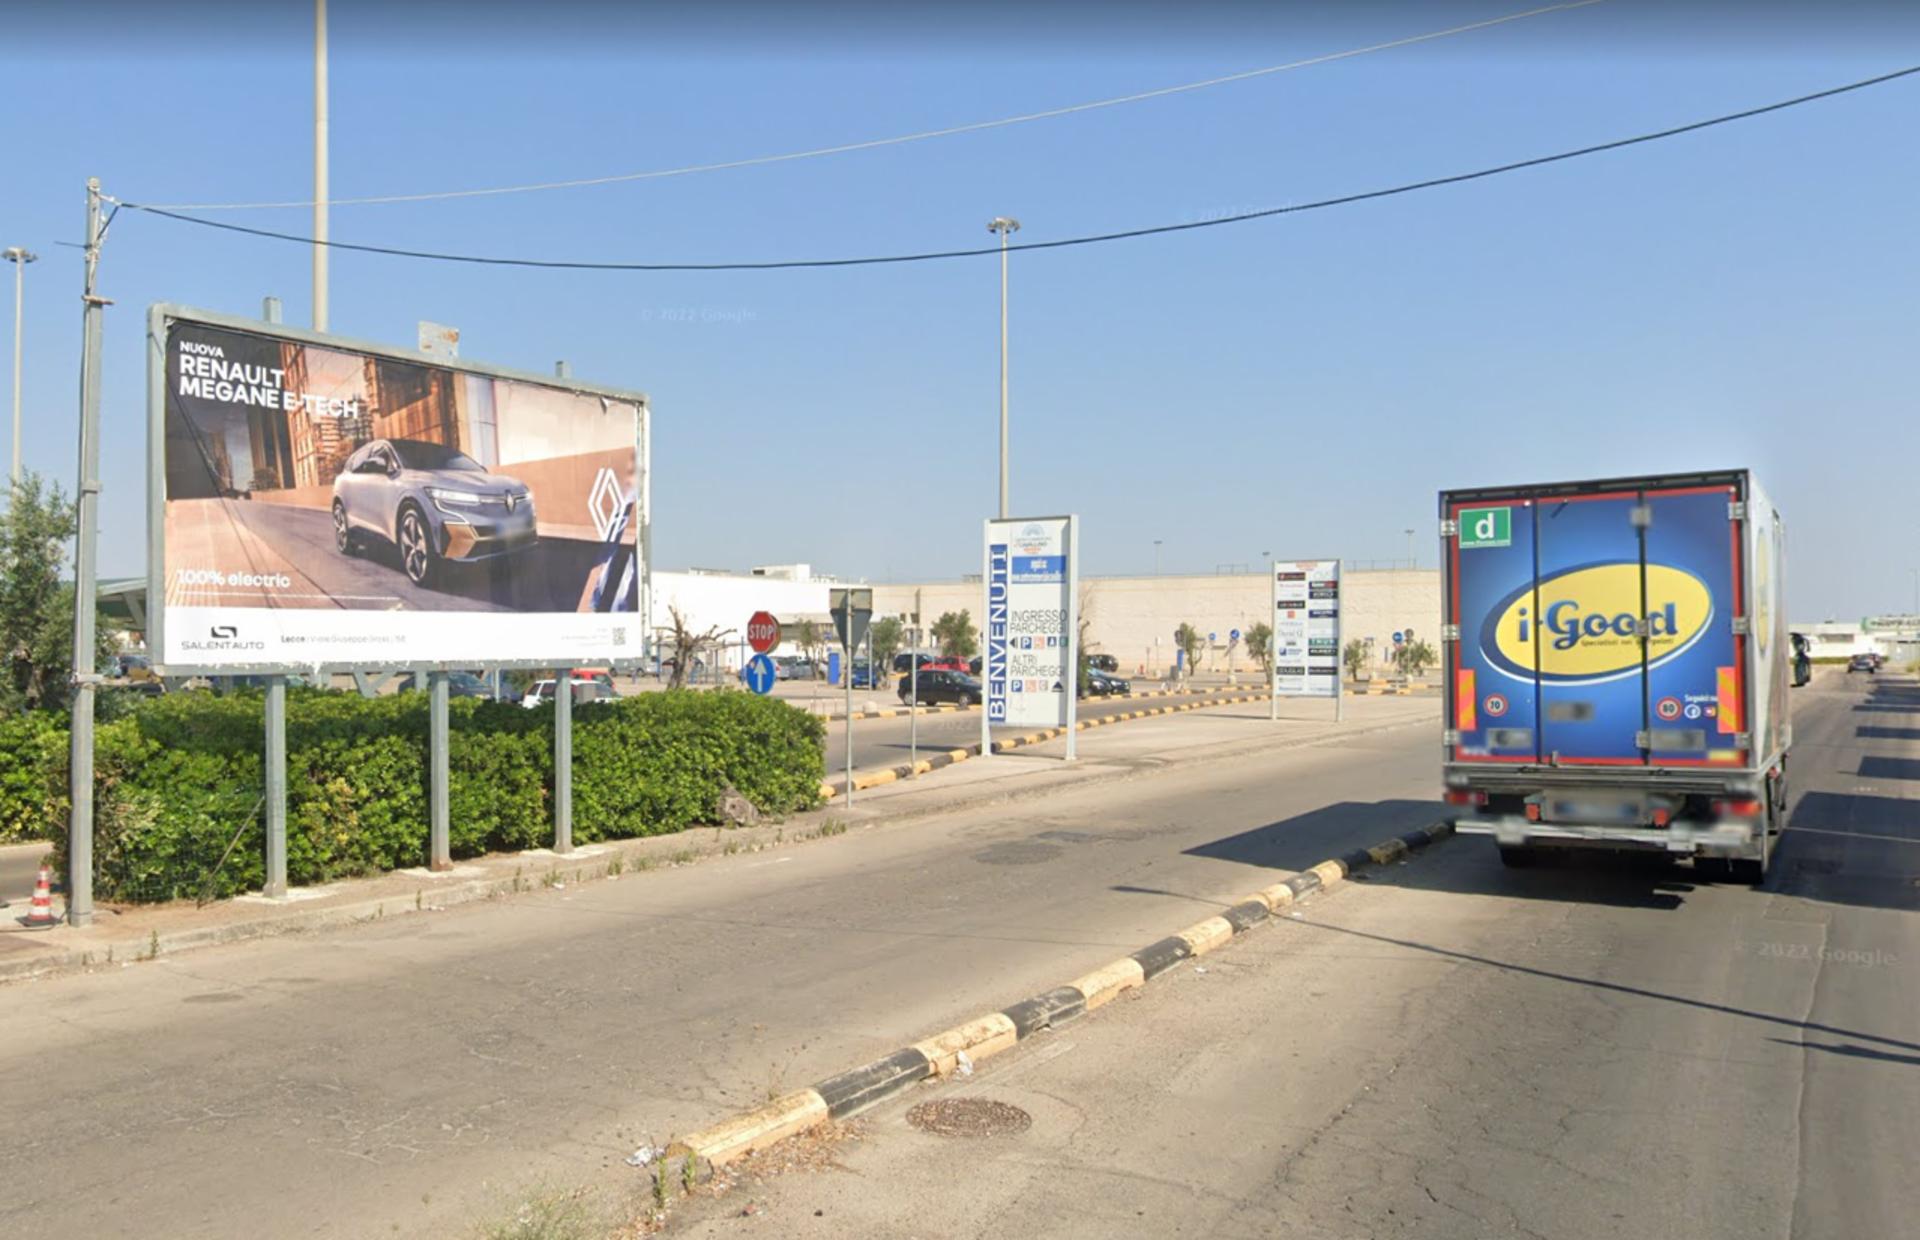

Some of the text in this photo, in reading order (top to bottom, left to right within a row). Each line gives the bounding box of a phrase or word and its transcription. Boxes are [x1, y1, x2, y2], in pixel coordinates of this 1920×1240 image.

[179, 340, 225, 358] NUOVA
[179, 353, 286, 389] RENAULT
[179, 375, 359, 419] MEGANE E-TECH
[1475, 512, 1494, 539] d
[176, 569, 291, 588] 100% electric
[1011, 609, 1068, 622] INGRESSO
[749, 624, 774, 640] STOP
[989, 550, 1007, 720] BENVENUTI
[1010, 622, 1067, 634] PARCHEGGI
[181, 641, 265, 650] SALENTAUTO
[1012, 654, 1038, 666] ALTRI
[1010, 665, 1065, 677] PARCHEGGI
